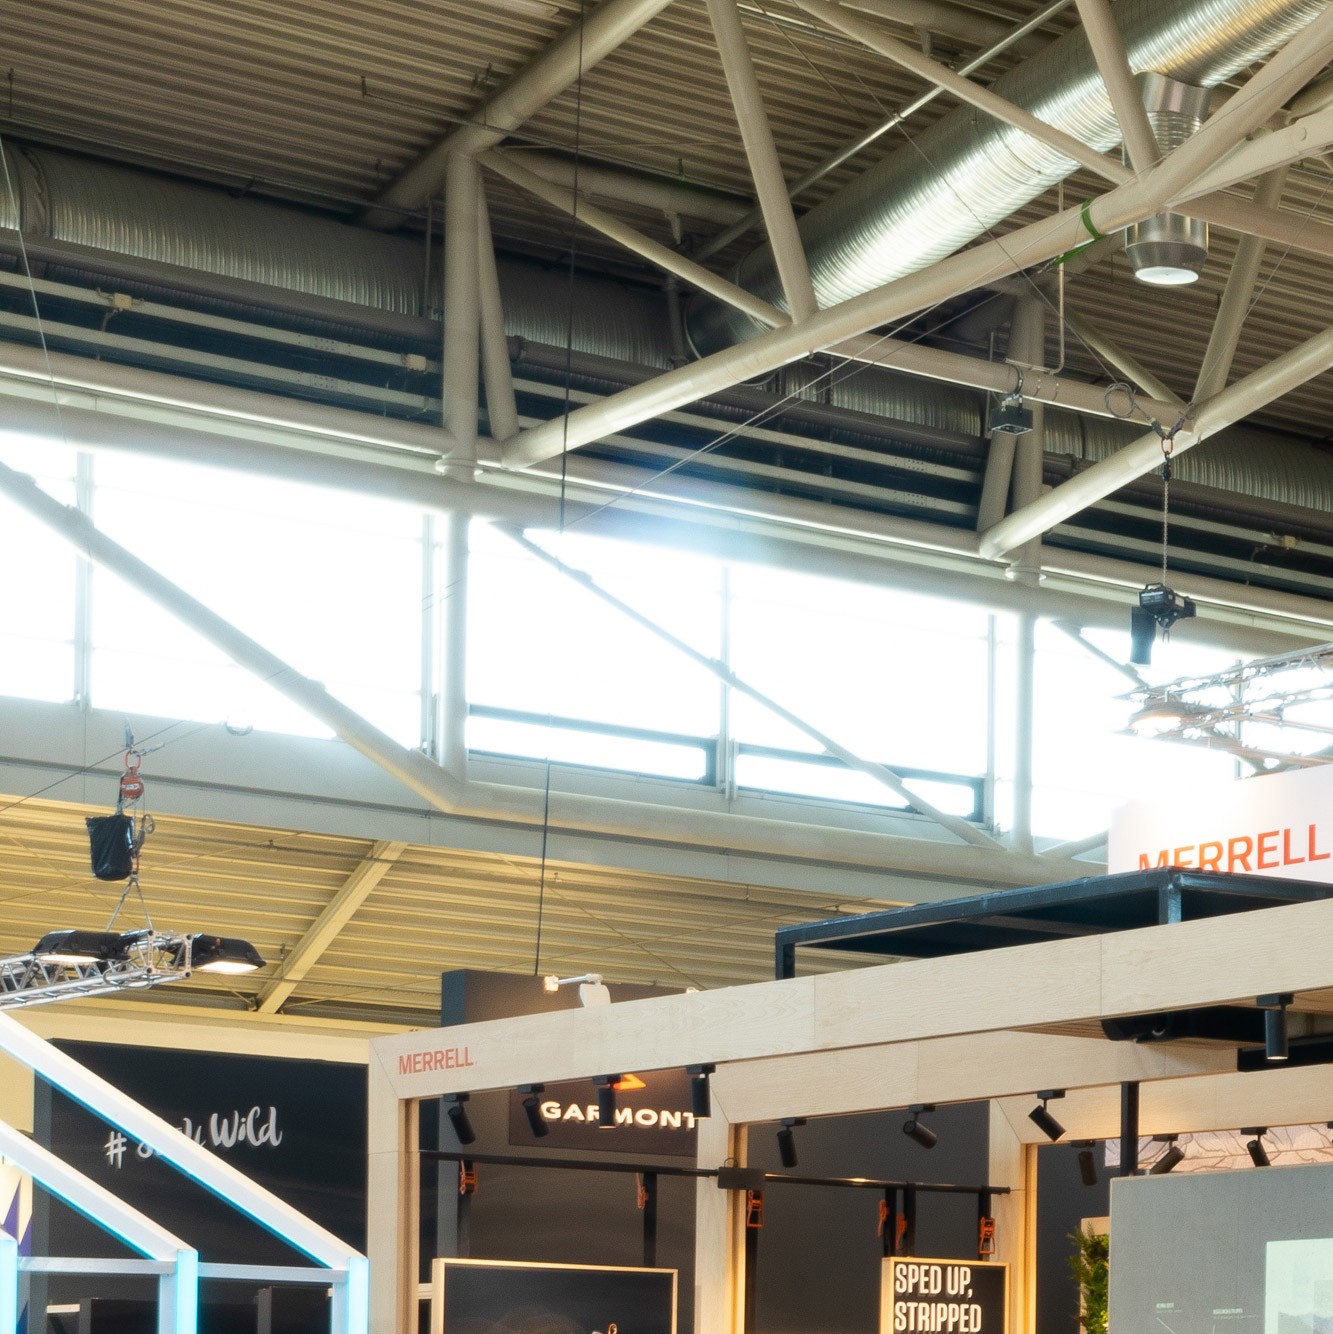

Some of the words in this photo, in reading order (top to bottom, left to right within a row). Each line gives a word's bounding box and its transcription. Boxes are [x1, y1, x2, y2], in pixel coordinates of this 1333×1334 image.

[399, 1047, 474, 1075] MERRELL
[210, 1106, 283, 1148] Wild
[540, 1101, 696, 1129] GARMONT
[895, 1264, 942, 1294] SPED
[947, 1266, 973, 1298] UP,
[894, 1301, 982, 1333] STRIPPED
